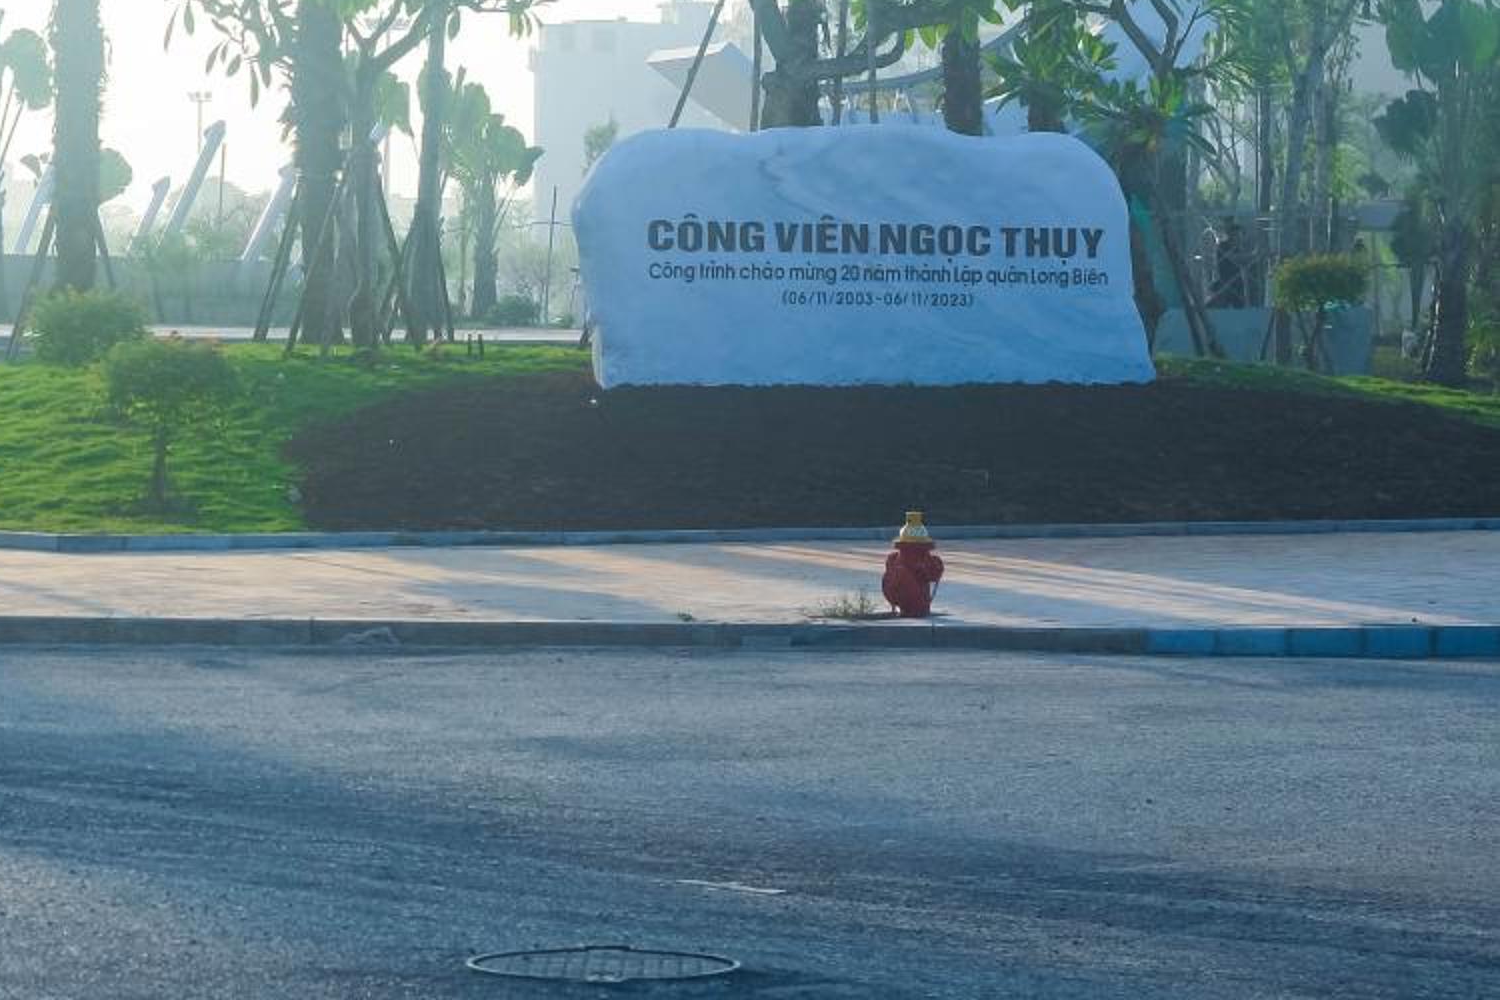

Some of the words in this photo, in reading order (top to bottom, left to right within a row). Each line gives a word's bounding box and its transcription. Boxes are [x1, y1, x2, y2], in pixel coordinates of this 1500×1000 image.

[648, 213, 765, 252] CÔNG
[775, 214, 869, 253] VIÊN
[879, 223, 991, 263] NGỌC
[1000, 227, 1104, 265] THỤY
[649, 261, 696, 283] Công
[699, 260, 735, 280] trình
[739, 261, 785, 281] chào
[841, 264, 860, 281] 20
[864, 263, 901, 282] năm
[904, 263, 951, 283] thành
[1072, 267, 1109, 286] Biên
